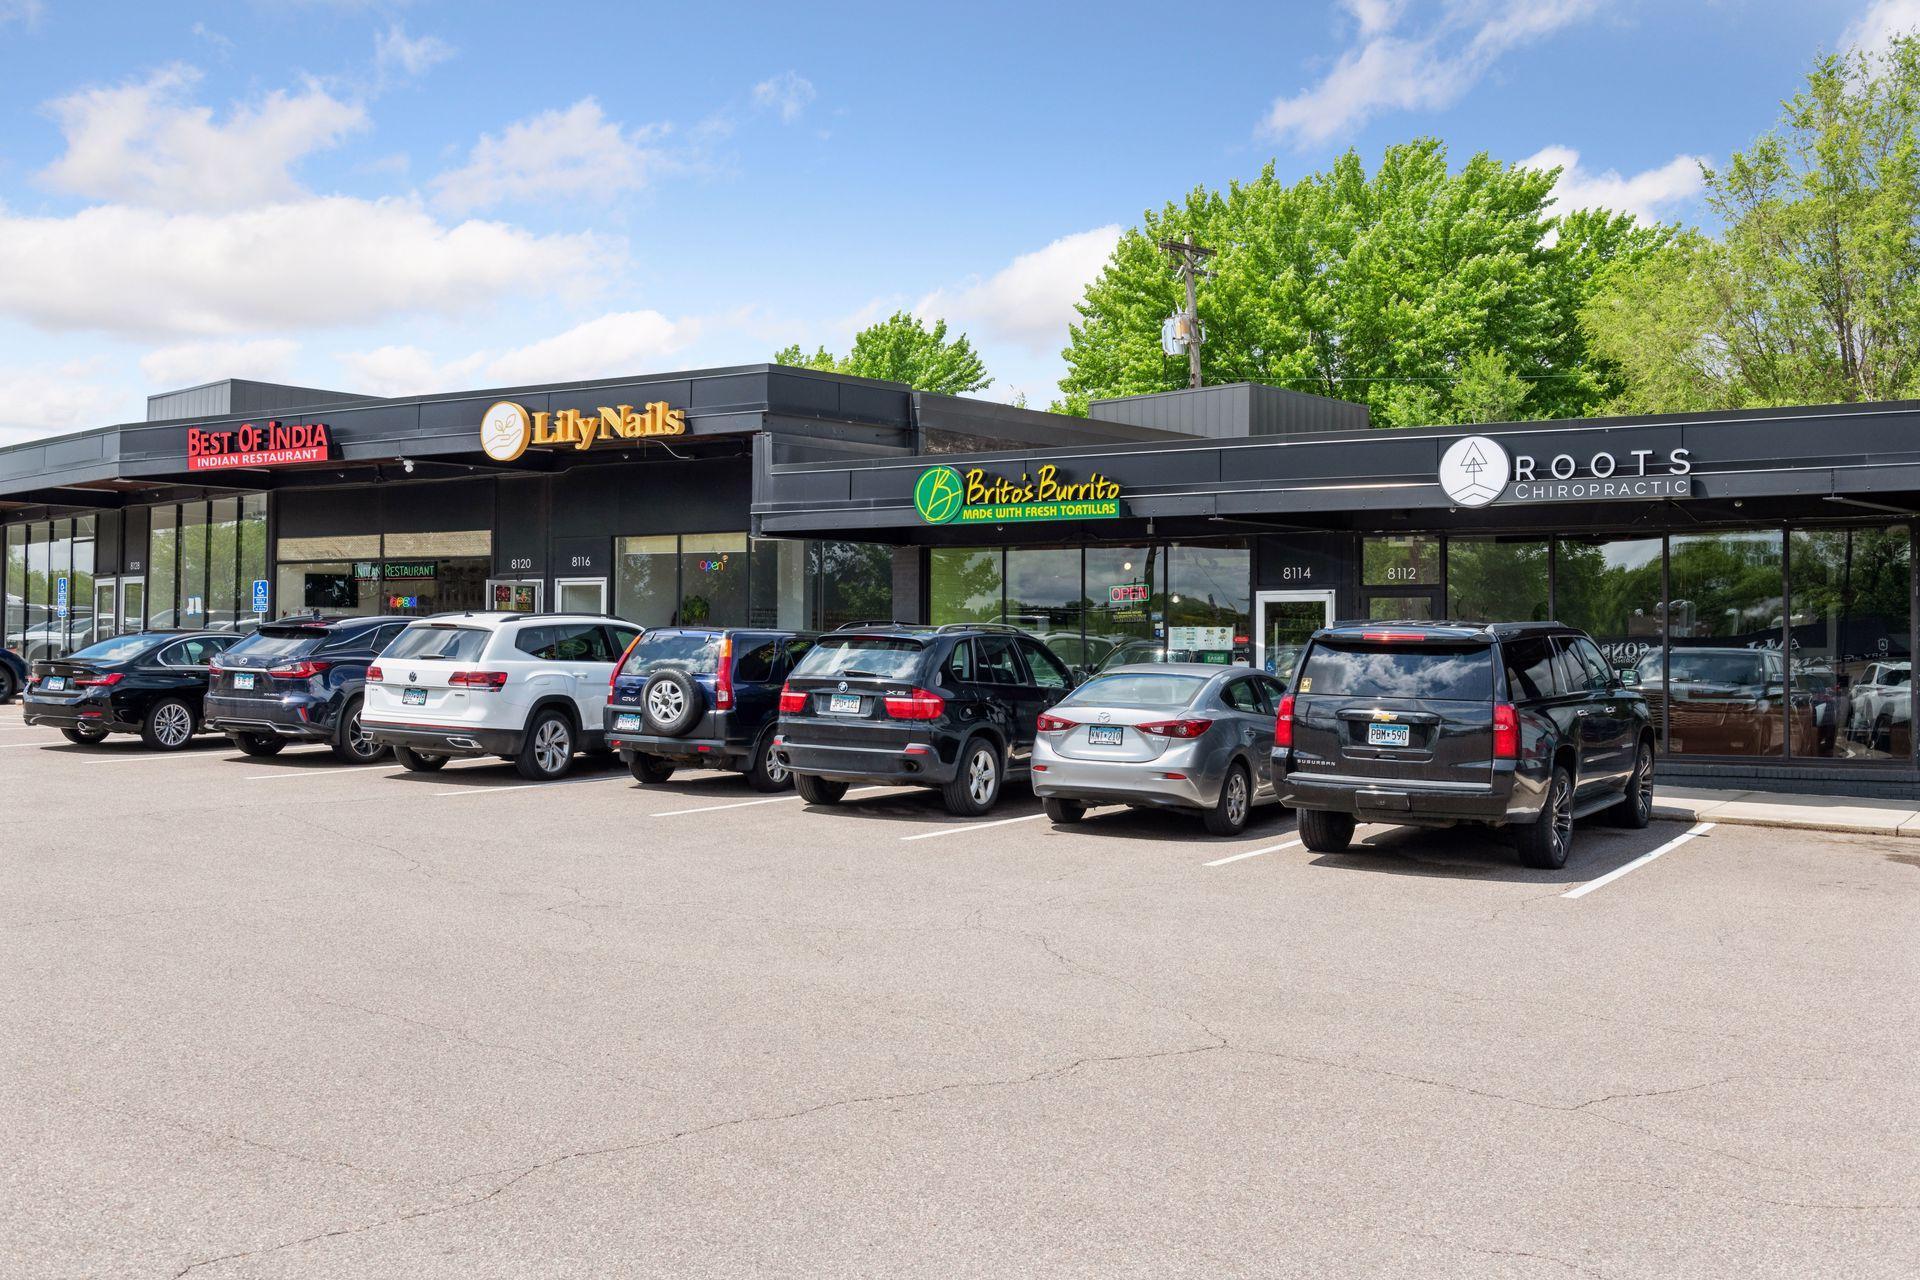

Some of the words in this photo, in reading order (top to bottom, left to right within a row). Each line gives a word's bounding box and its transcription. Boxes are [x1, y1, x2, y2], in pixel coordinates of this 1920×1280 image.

[531, 408, 598, 450] Lily
[597, 400, 686, 439] Nails
[197, 455, 239, 467] INDIAN
[242, 449, 319, 464] RESTAURANT
[1515, 448, 1692, 482] ROOTS
[966, 468, 1034, 506] Brito's
[1038, 464, 1120, 502] Burrito
[1515, 480, 1688, 499] CHIROPRACTIC
[962, 507, 993, 520] MADE
[995, 506, 1023, 518] WITH
[1025, 505, 1057, 517] FRESH
[1060, 503, 1116, 516] TORTILLAS
[511, 558, 531, 569] 8120
[571, 556, 591, 567] 8116
[700, 560, 724, 572] open
[384, 564, 435, 577] RESTAURANT
[1283, 567, 1311, 580] 8114
[1387, 567, 1416, 580] 8112
[1111, 586, 1148, 601] OPEN
[389, 595, 417, 608] OPEN
[1370, 729, 1387, 741] PBM
[1391, 730, 1408, 741] 590
